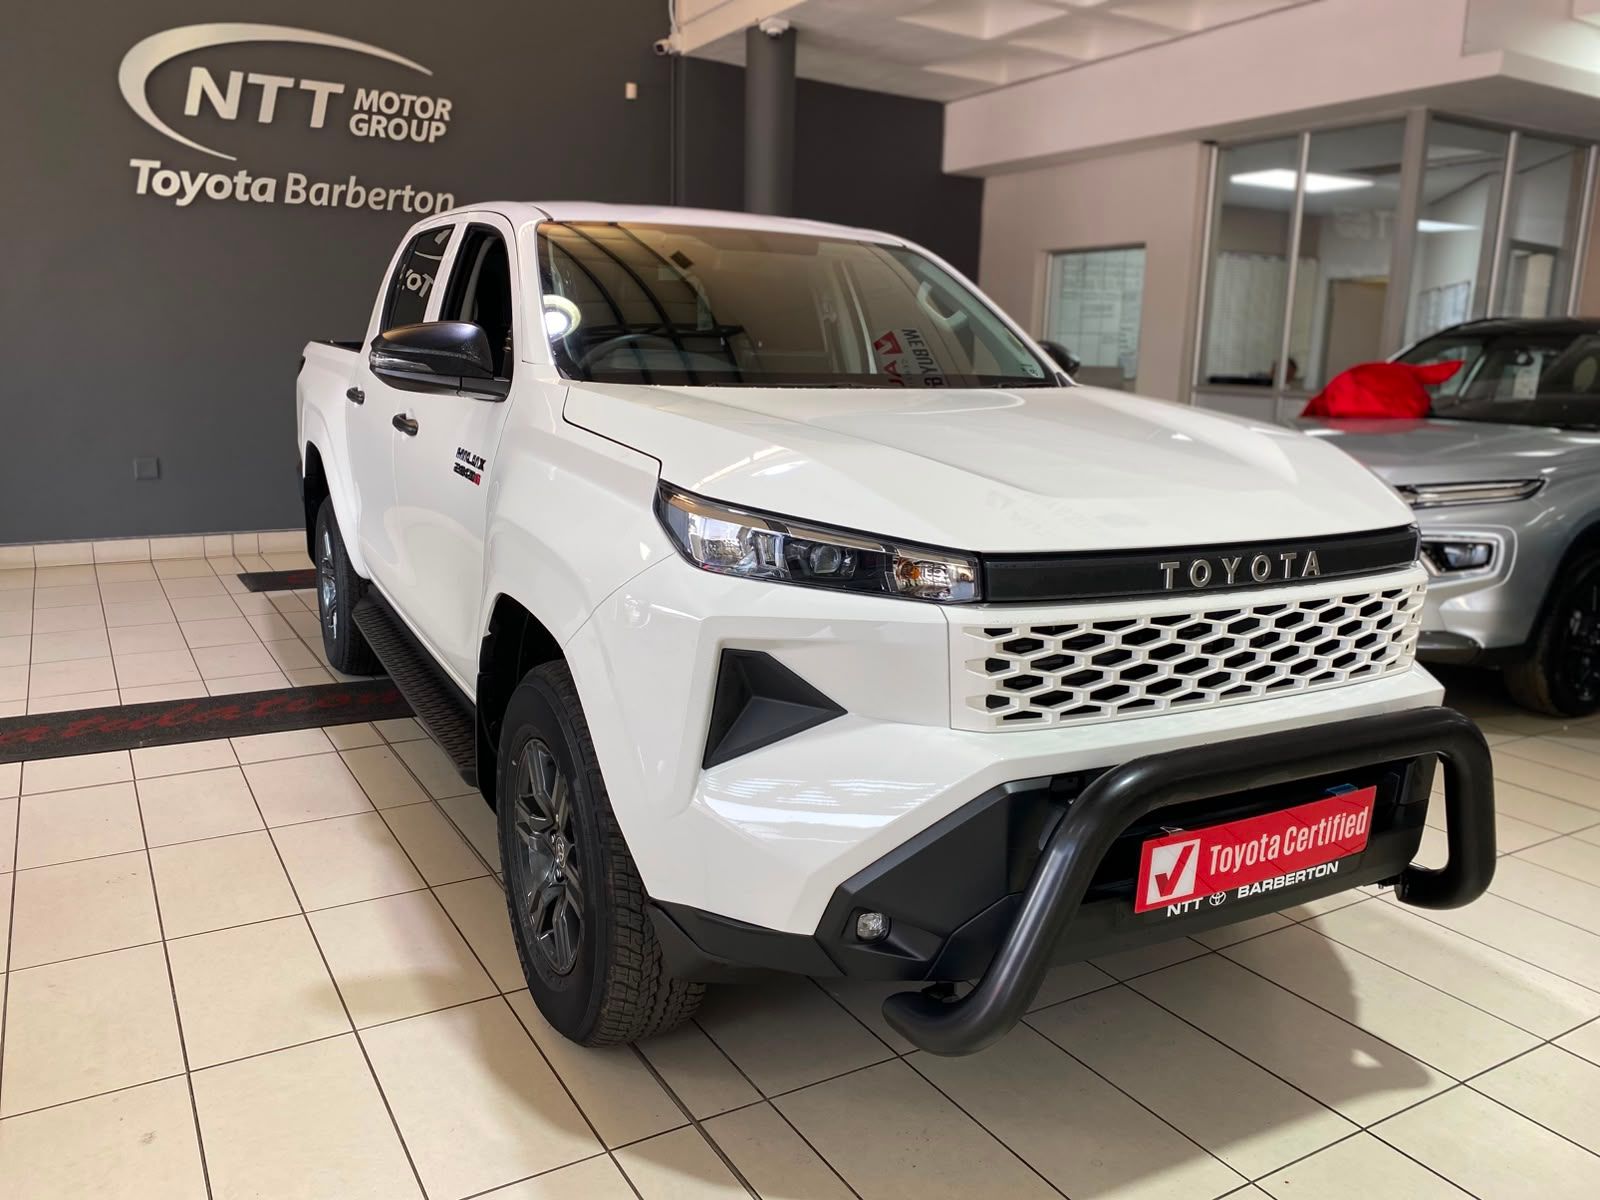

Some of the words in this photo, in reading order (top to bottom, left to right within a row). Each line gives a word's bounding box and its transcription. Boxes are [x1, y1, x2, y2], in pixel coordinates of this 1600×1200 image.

[184, 66, 345, 129] NTT
[353, 88, 453, 121] MOTOR
[349, 113, 447, 143] GROUP
[129, 158, 277, 207] Toyota
[284, 172, 455, 215] Barberton
[1160, 550, 1321, 590] TOYOTA
[1209, 832, 1281, 876] Toyota
[1283, 806, 1369, 857] Certified
[1166, 896, 1204, 917] NTT
[1237, 860, 1340, 899] BARBERTON
